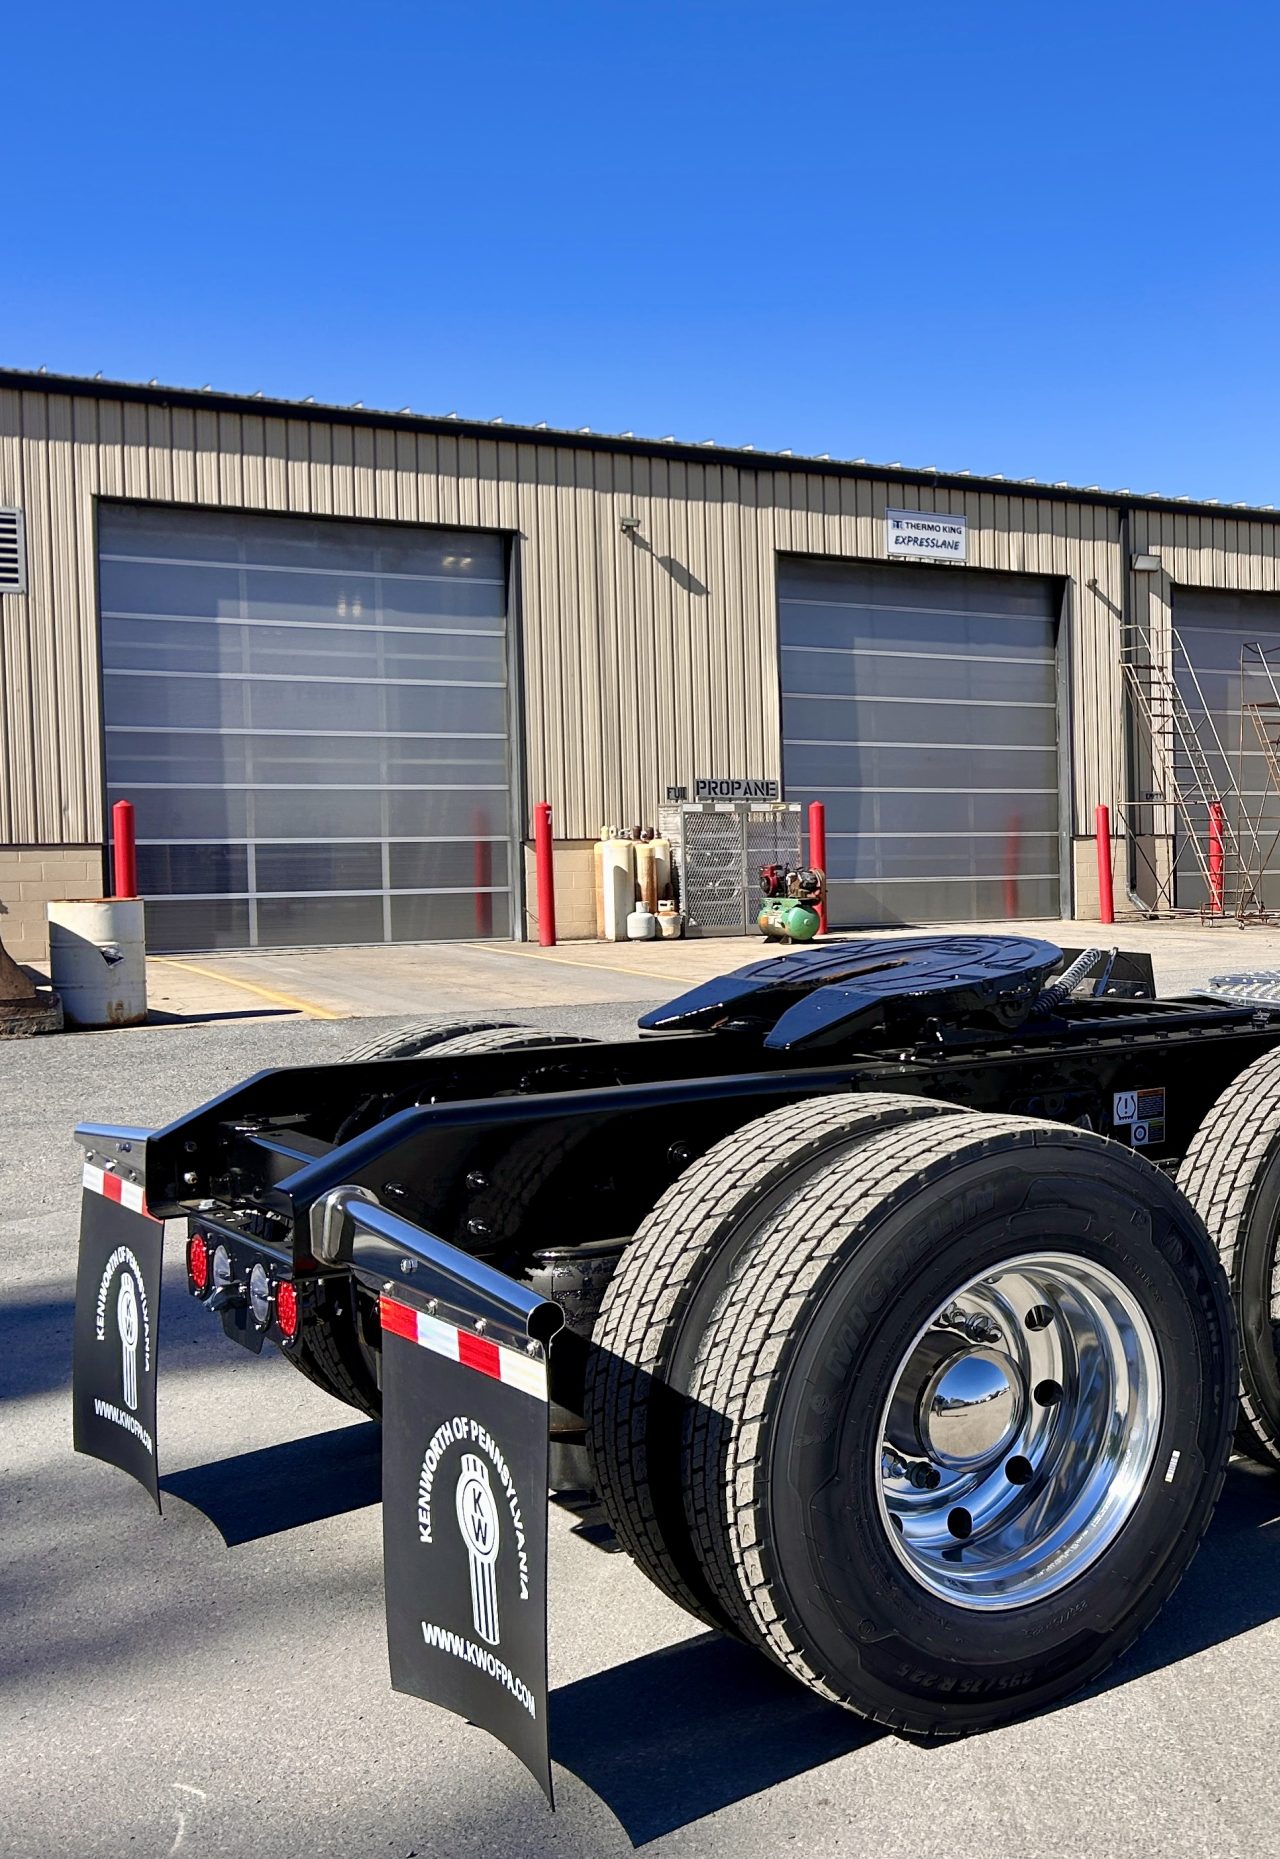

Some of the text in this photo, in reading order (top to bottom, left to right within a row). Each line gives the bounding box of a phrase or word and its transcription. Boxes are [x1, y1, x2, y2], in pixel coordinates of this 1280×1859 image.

[894, 535, 960, 550] EXPRESSLANE
[905, 521, 941, 533] THERMO
[942, 525, 962, 535] KING
[696, 780, 776, 797] PROPANE
[96, 1249, 120, 1341] KENWORTH
[418, 1416, 529, 1600] KENWORTH OF PENNSYLVANIA
[421, 1620, 536, 1720] WWW.KWOFPA.COM
